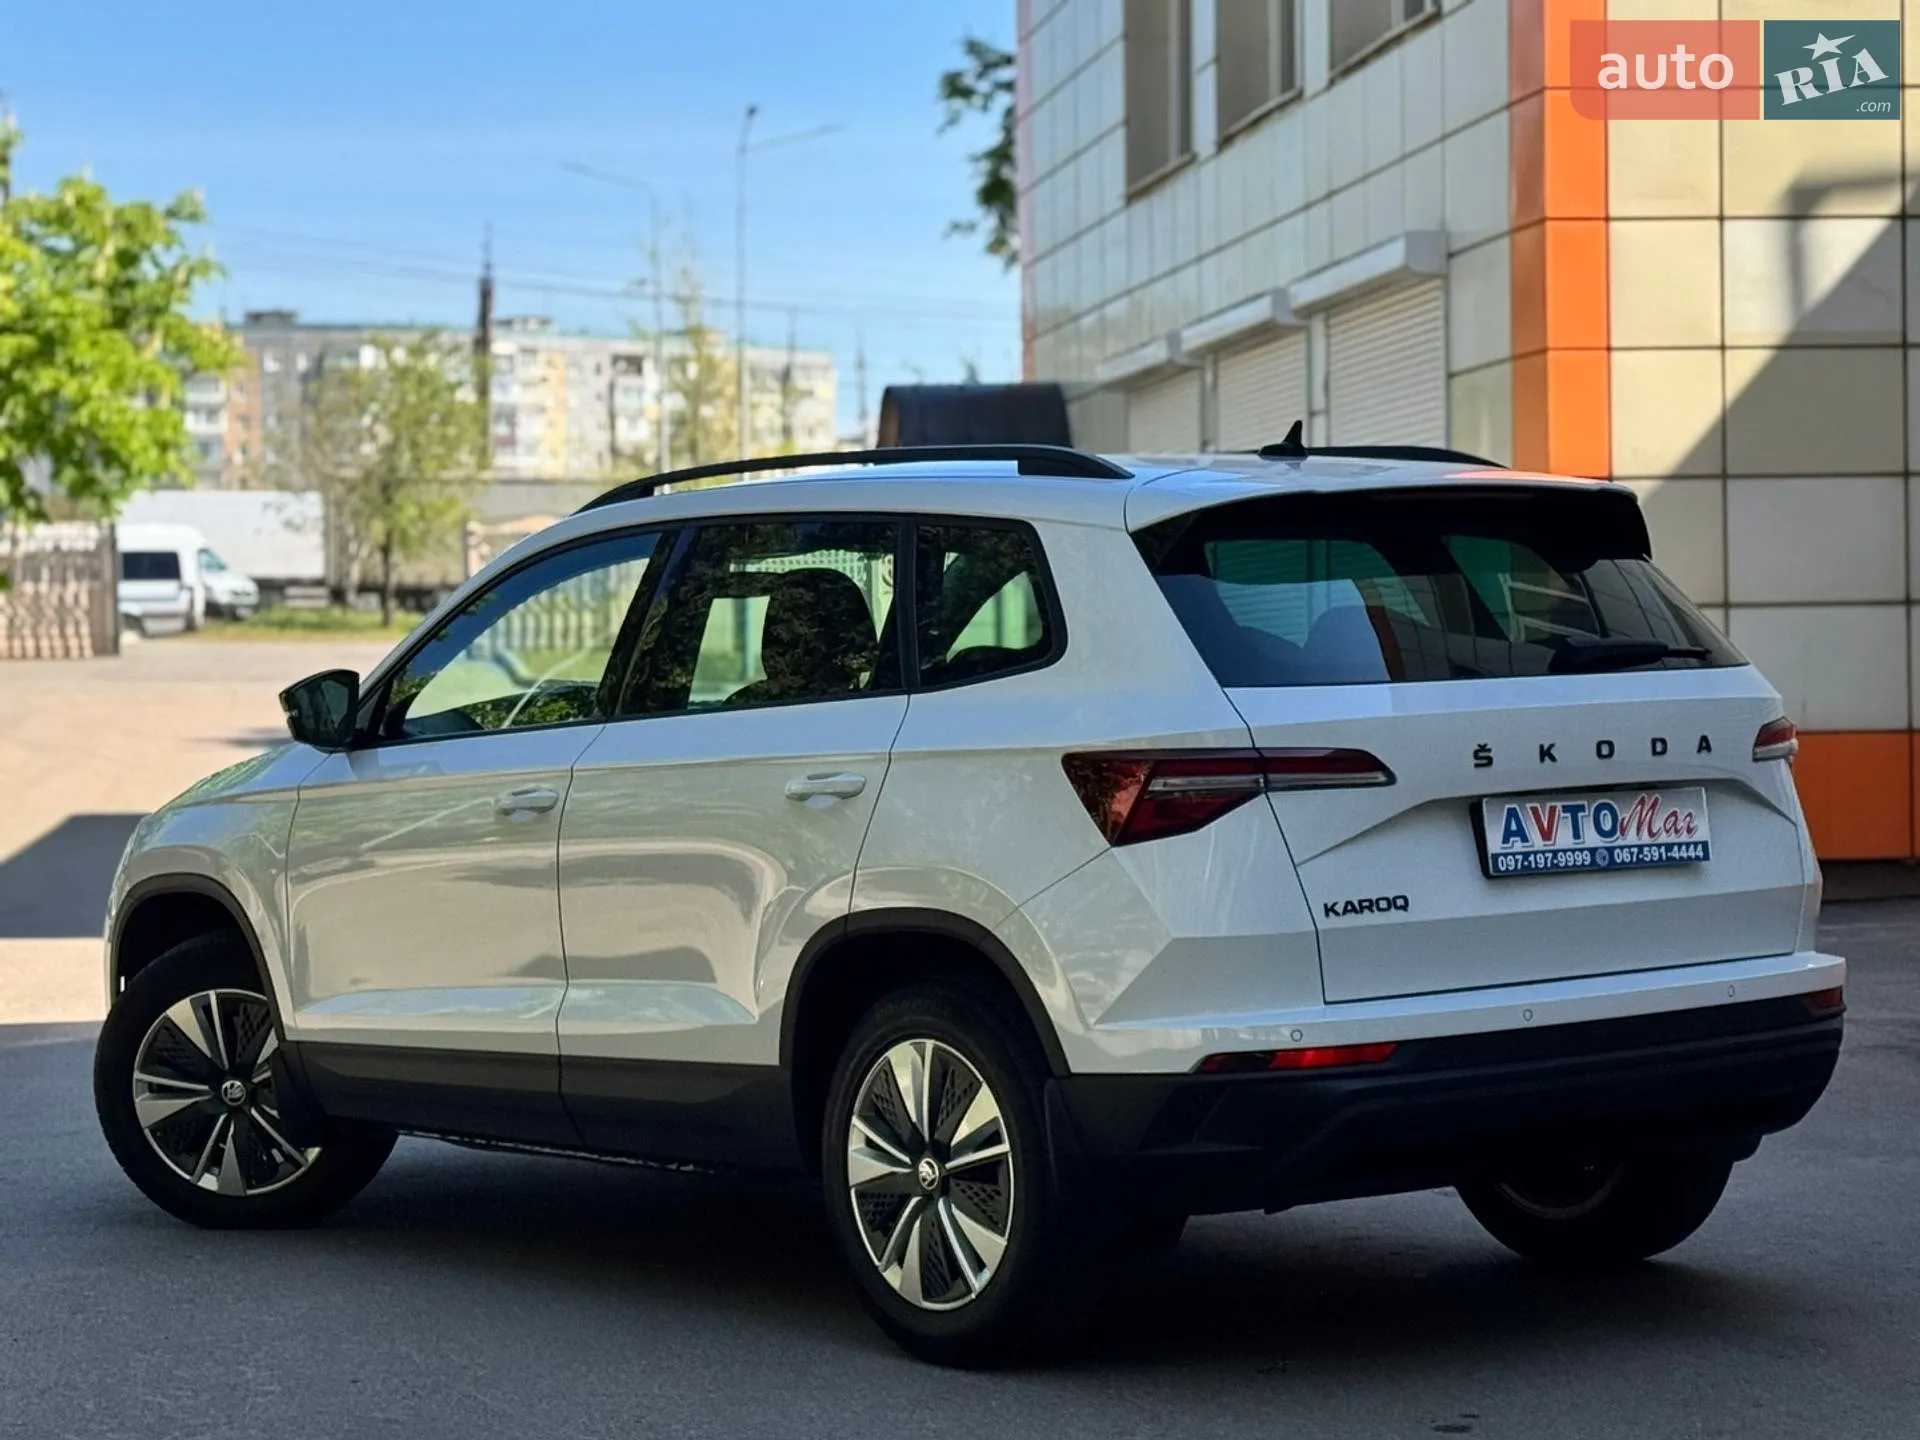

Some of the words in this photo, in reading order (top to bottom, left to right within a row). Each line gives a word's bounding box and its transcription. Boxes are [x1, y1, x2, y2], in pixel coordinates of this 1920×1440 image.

[1472, 735, 1712, 768] ŠKODA
[1498, 850, 1591, 872] 097-197-9999
[1613, 844, 1704, 864] 067-591-4444
[1323, 894, 1410, 919] KAROQ
